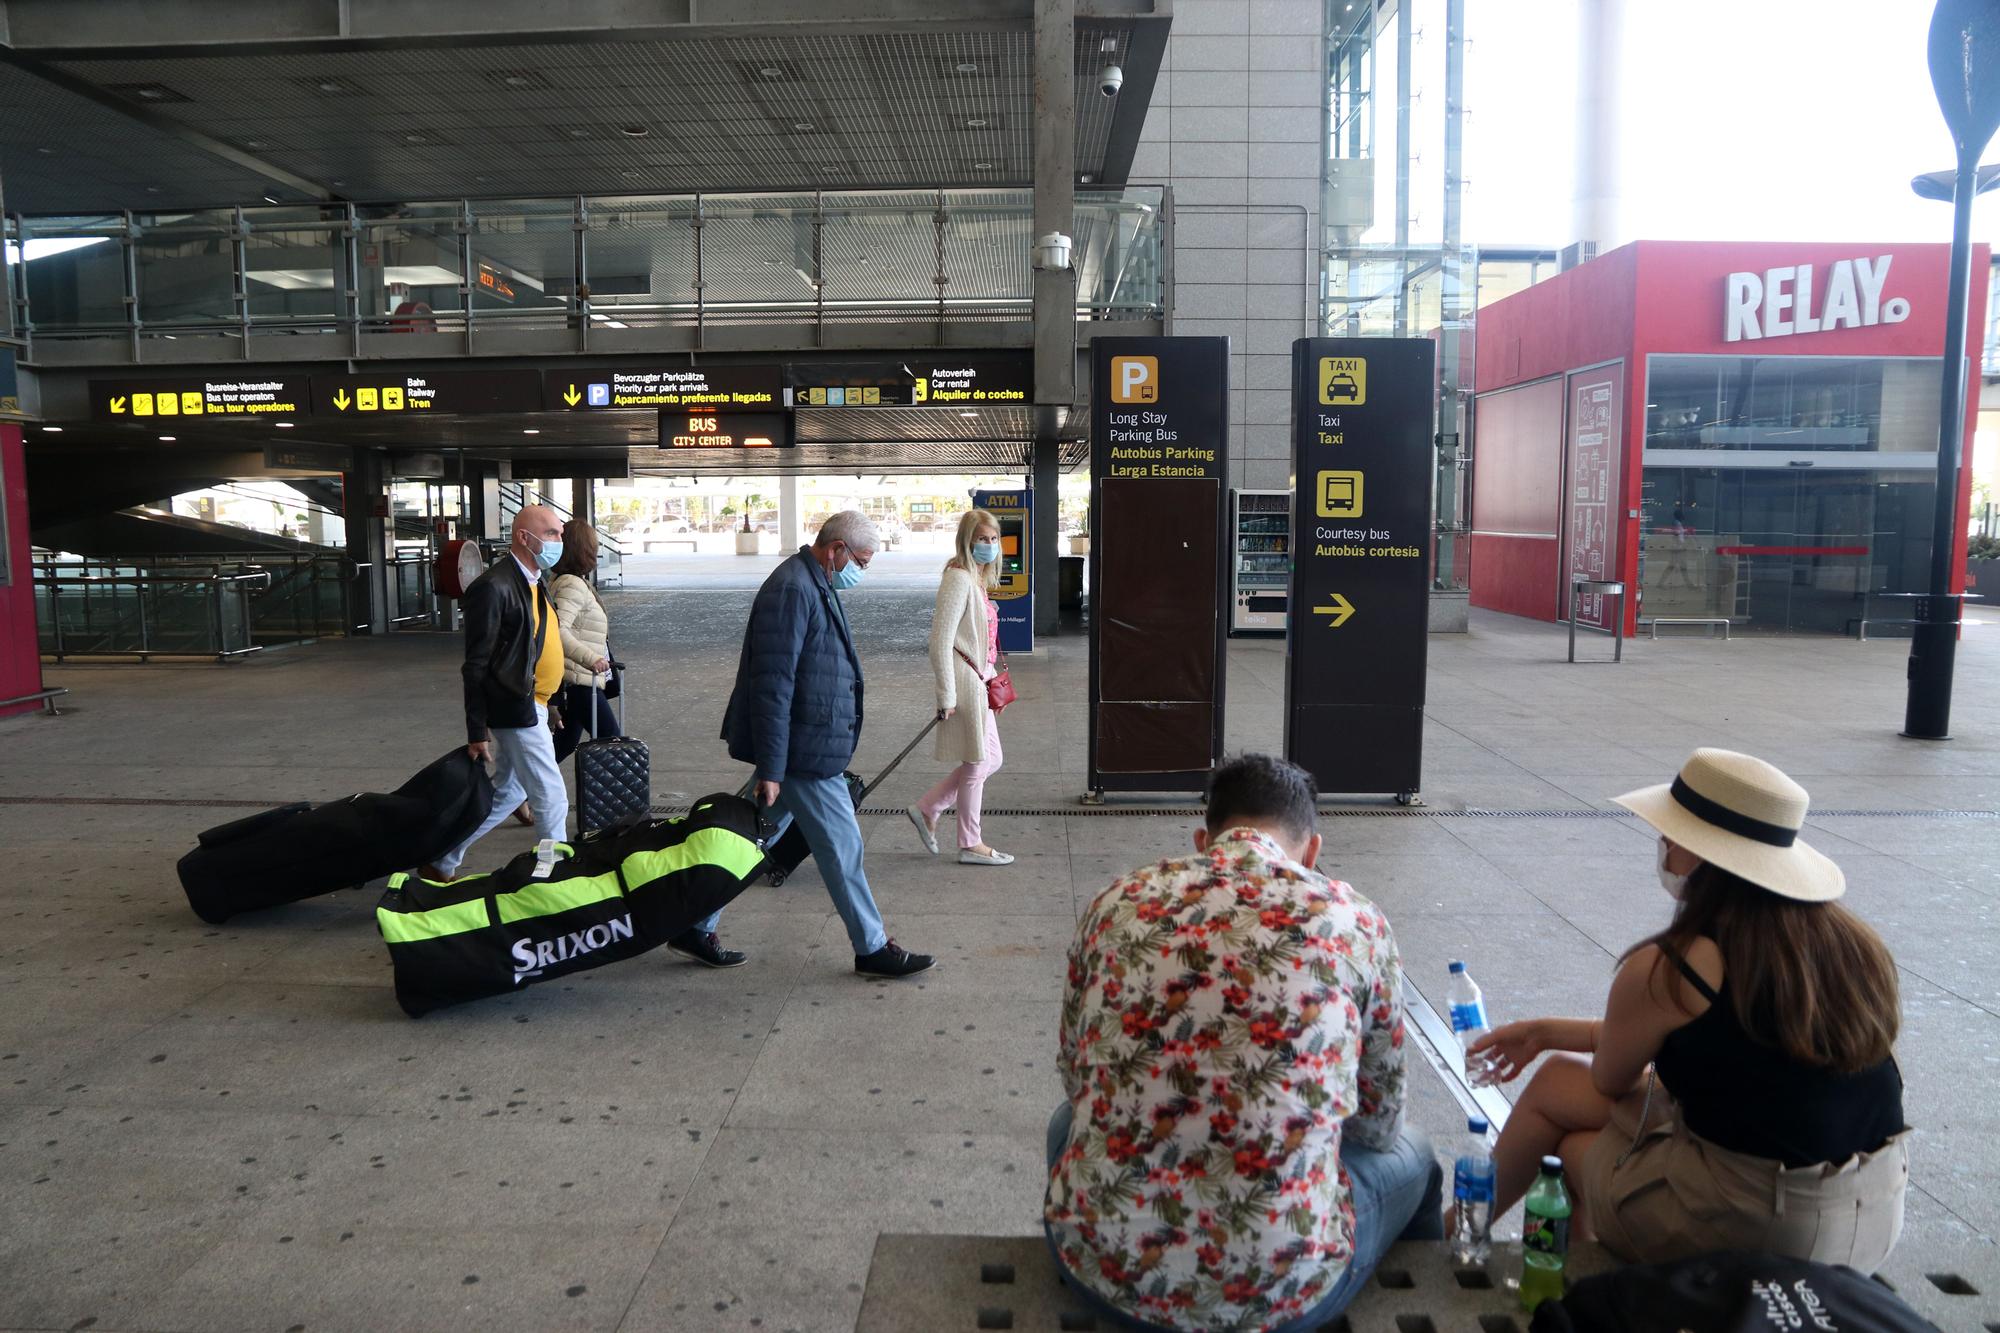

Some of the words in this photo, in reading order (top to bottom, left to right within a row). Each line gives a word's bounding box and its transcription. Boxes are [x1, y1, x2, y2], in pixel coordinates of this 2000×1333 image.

[1329, 360, 1357, 371] TAXI
[614, 373, 661, 384] Bevorzugter
[663, 372, 705, 383] Parkplätze
[931, 368, 976, 378] Autoverleih
[407, 377, 426, 387] Bahn
[931, 379, 947, 388] Car
[947, 378, 970, 388] rental
[1122, 362, 1149, 398] P
[205, 382, 284, 392] Busreise-Veranstalter
[407, 387, 436, 398] Railway
[613, 383, 643, 394] Priority
[644, 385, 657, 393] car
[658, 383, 677, 394] park
[679, 382, 709, 392] arrivals
[206, 392, 221, 402] Bus
[223, 393, 238, 402] tour
[239, 392, 276, 403] operators
[592, 386, 605, 403] P
[613, 393, 680, 406] Aparcamiento
[681, 392, 730, 405] preferente
[732, 391, 772, 405] llegadas
[932, 389, 971, 402] Alquiler
[972, 389, 986, 400] de
[987, 389, 1025, 400] coches
[207, 403, 225, 413] Bus
[227, 404, 245, 413] tour
[246, 401, 296, 414] operadores
[408, 399, 431, 408] Tren
[689, 417, 717, 433] BUS
[1109, 412, 1139, 427] Long
[1141, 411, 1168, 426] Stay
[1318, 414, 1340, 427] Taxi
[673, 437, 696, 447] CITY
[698, 436, 733, 446] CENTER
[1109, 428, 1153, 444] Parking
[1156, 428, 1178, 441] Bus
[1317, 431, 1344, 445] Taxi
[1110, 446, 1162, 459] Autobús
[1165, 446, 1215, 462] Parking
[1111, 463, 1148, 478] Larga
[1151, 464, 1205, 477] Estancia
[987, 495, 1018, 507] ATM
[1315, 526, 1367, 542] Courtesy
[1369, 527, 1390, 540] bus
[1314, 544, 1366, 557] Autobús
[1369, 545, 1420, 558] cortesía
[511, 913, 635, 980] SRIXON
